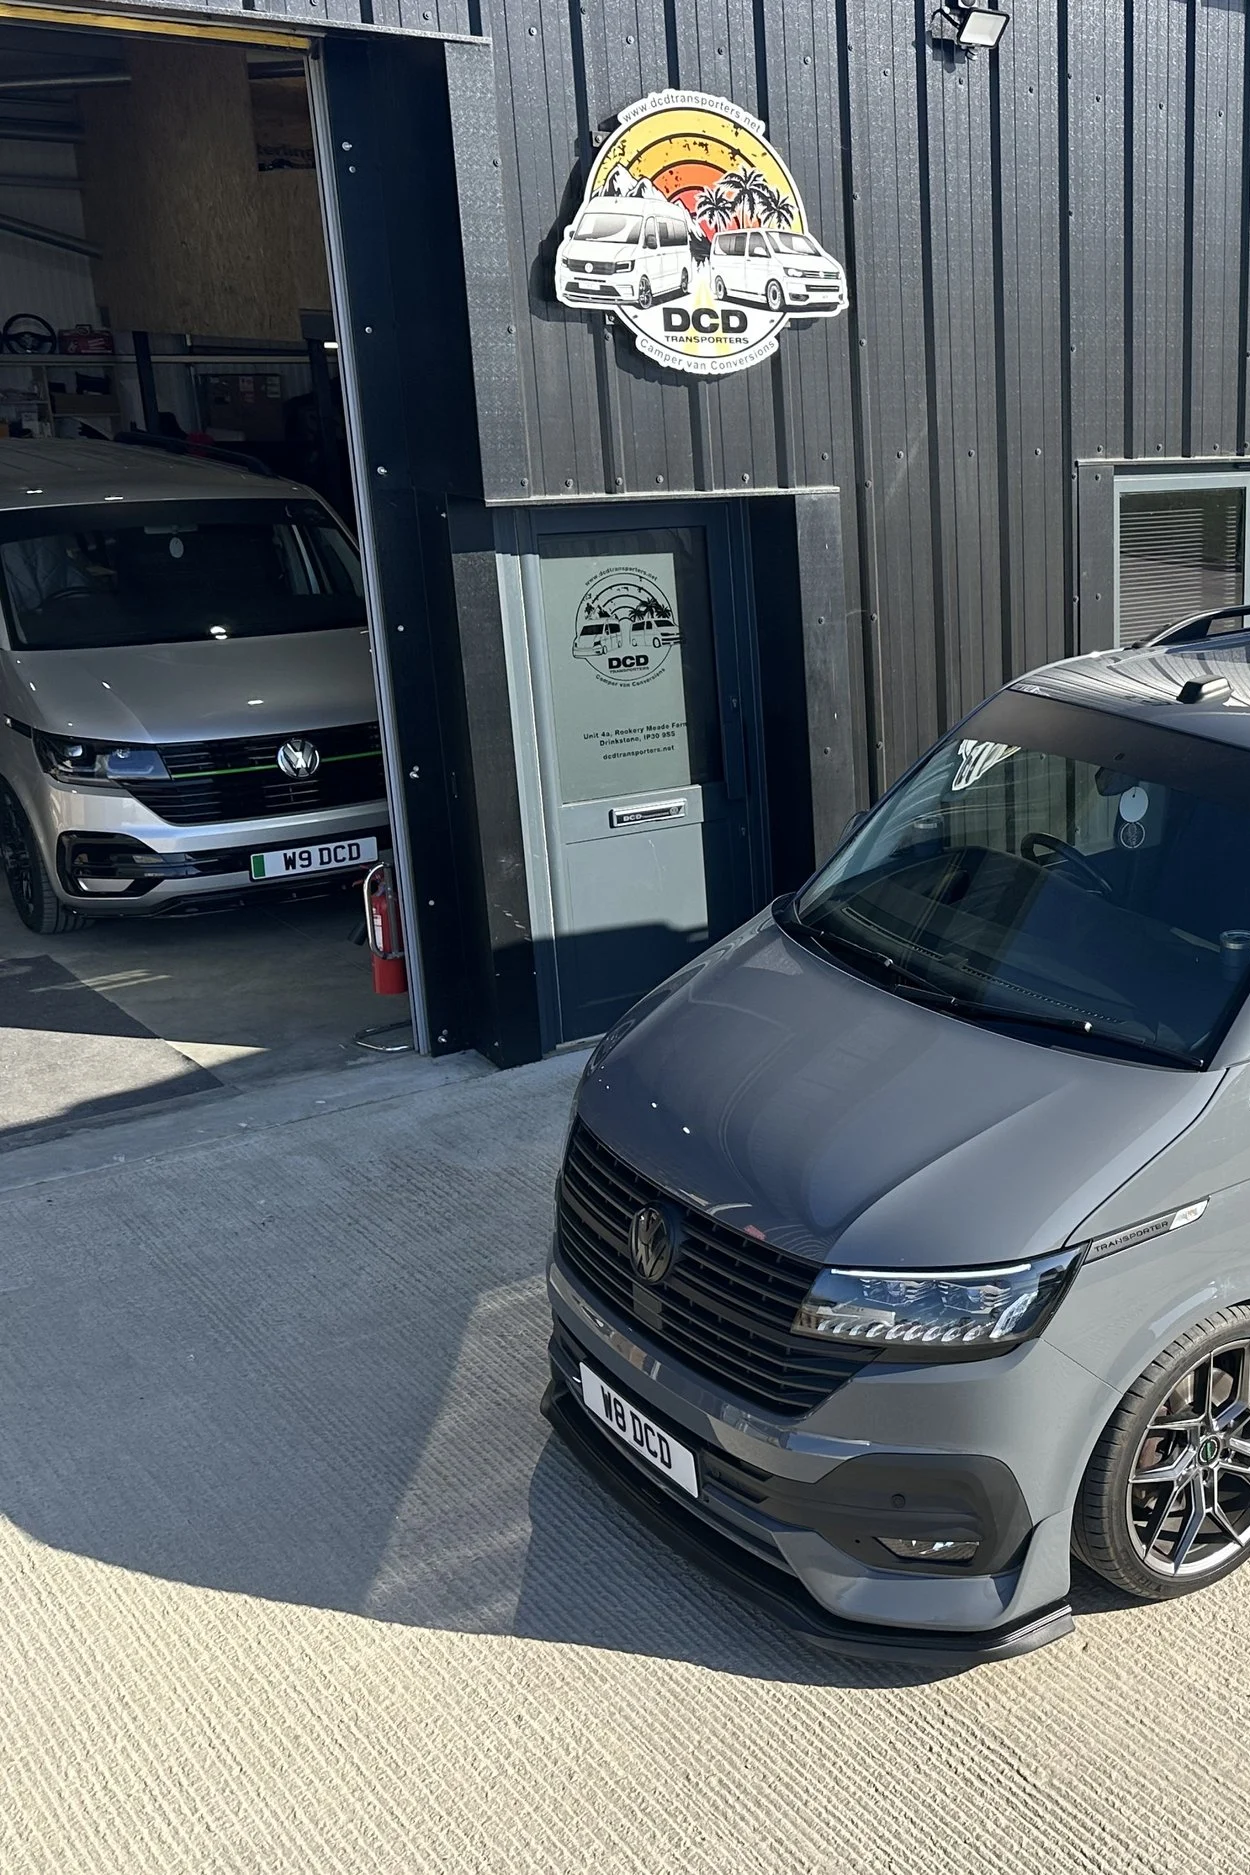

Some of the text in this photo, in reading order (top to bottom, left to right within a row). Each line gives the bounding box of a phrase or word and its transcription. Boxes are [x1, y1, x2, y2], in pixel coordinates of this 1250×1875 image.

[623, 93, 761, 134] www.dcdtransporters.net
[662, 307, 748, 334] DCD
[664, 335, 749, 345] TRANSPORTERS
[640, 338, 775, 371] Camper van Conversions
[608, 654, 649, 669] DCD
[615, 727, 644, 736] Rookery
[603, 745, 675, 760] dcdtransporters.net
[623, 814, 642, 822] DCD
[283, 842, 361, 871] W9 DCD
[1094, 1220, 1169, 1253] TRANSPORTER
[600, 1385, 672, 1469] W8 DCD
